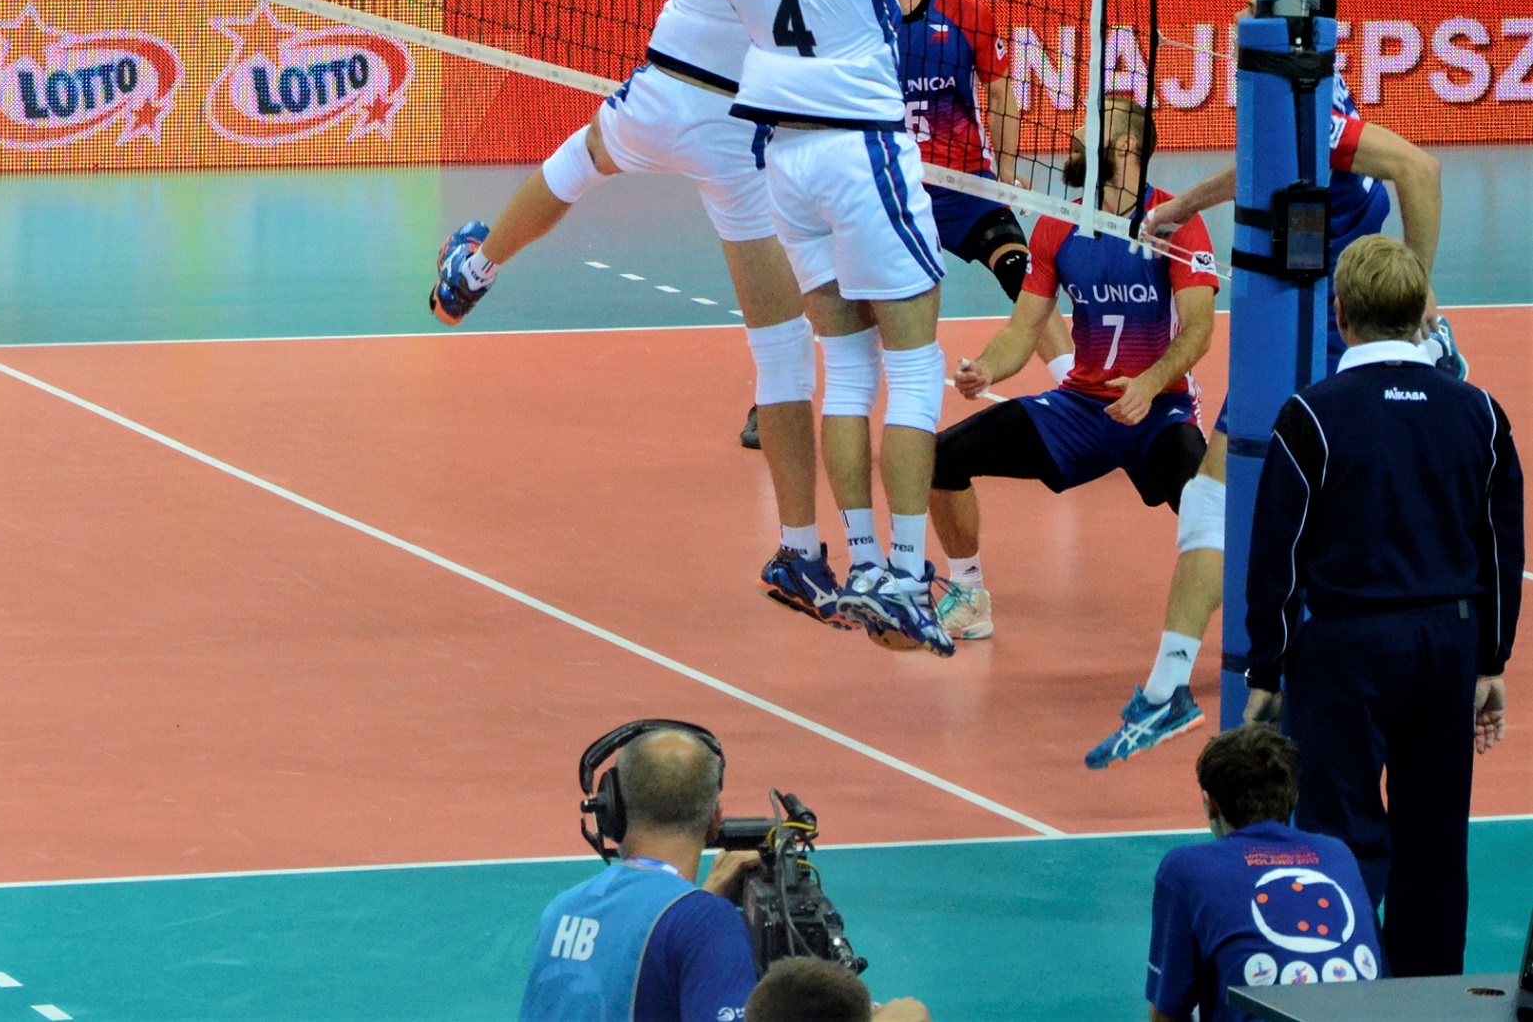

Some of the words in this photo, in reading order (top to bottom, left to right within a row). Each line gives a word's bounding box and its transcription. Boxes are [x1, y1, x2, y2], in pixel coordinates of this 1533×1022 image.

[17, 56, 137, 120] LOTTO
[252, 52, 369, 115] LOTTO
[1092, 283, 1158, 302] UNIQA
[1102, 314, 1125, 369] 7
[1384, 386, 1428, 401] MIKASA
[848, 535, 874, 546] rrea
[551, 915, 600, 961] HB
